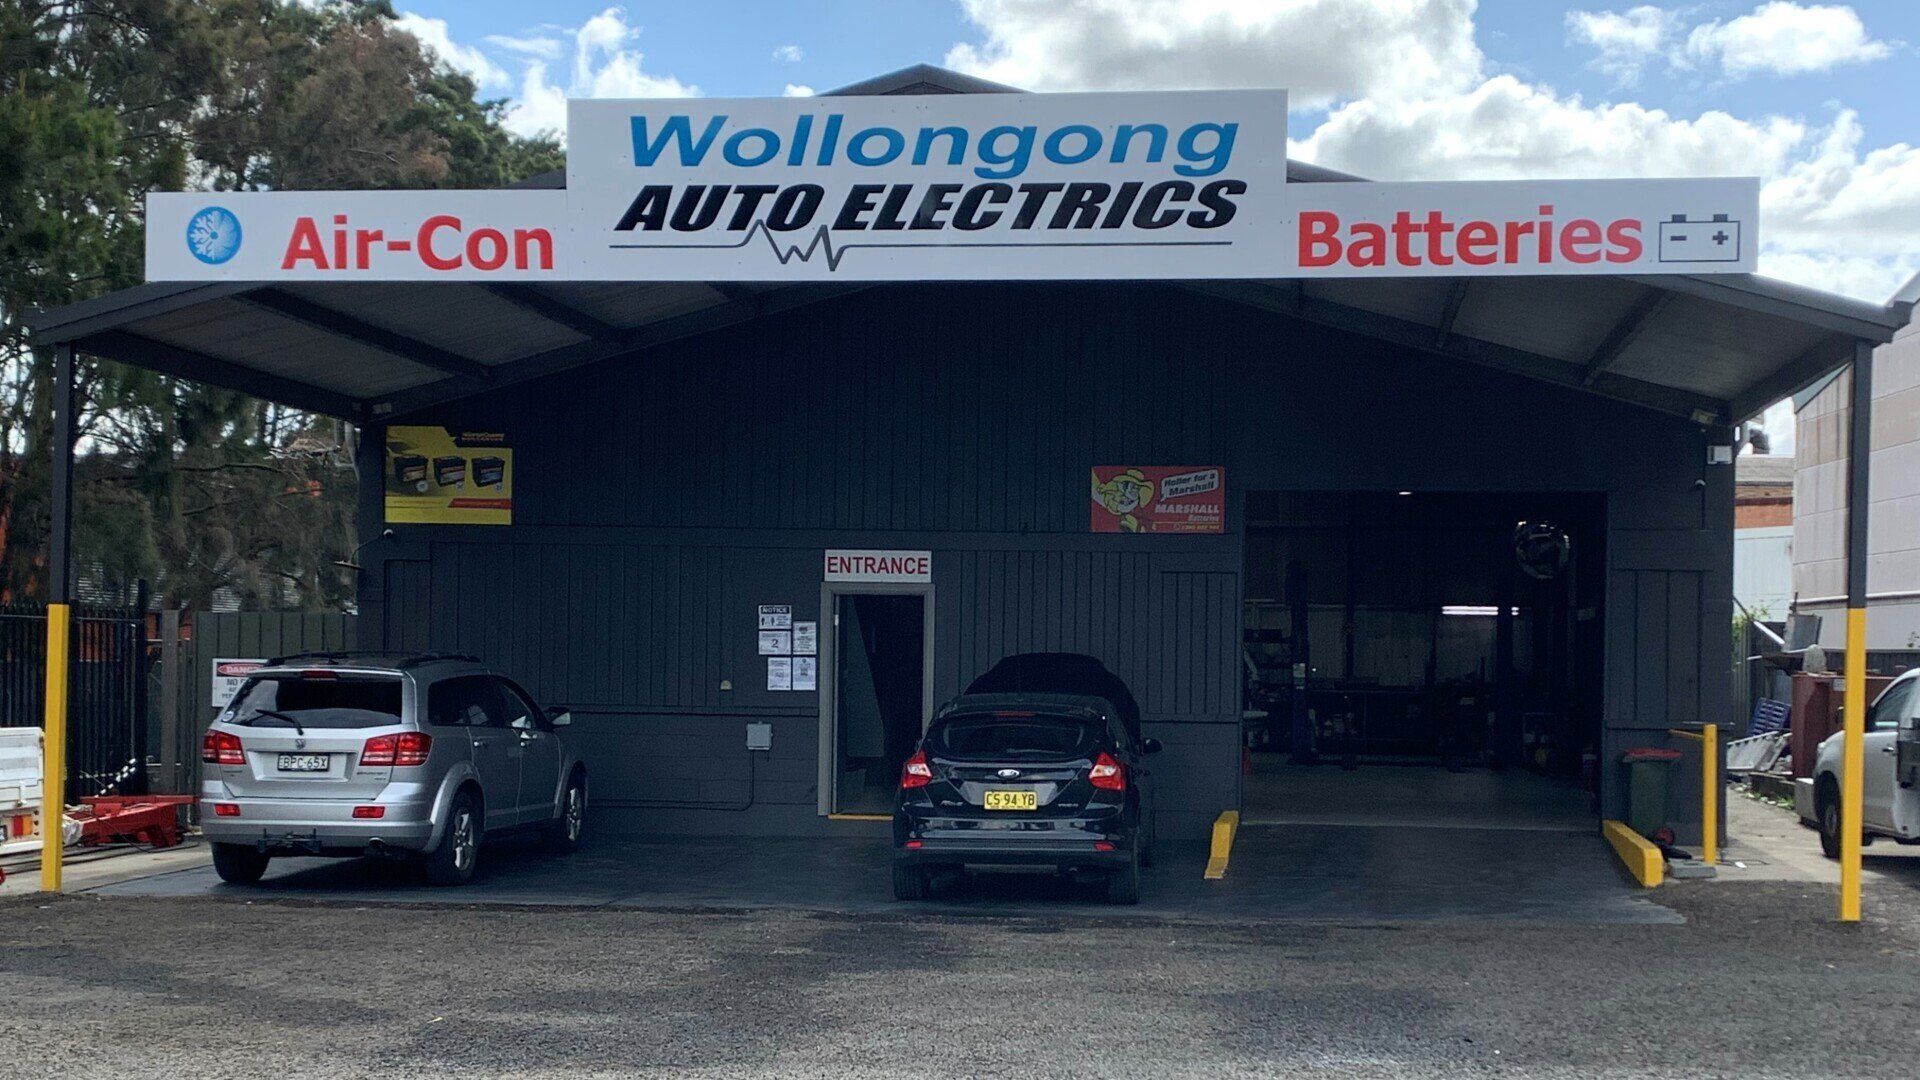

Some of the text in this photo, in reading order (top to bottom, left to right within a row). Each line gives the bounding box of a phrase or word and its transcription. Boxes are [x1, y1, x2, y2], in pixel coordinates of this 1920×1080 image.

[629, 114, 1239, 180] Wollongong
[614, 179, 1248, 231] AUTO ELECTRICS
[280, 214, 554, 272] Air-Con
[1298, 204, 1644, 268] Batteries
[1194, 474, 1208, 482] for
[1169, 481, 1214, 496] Marshall
[1155, 504, 1219, 513] MARSHALL
[827, 556, 928, 574] ENTRANCE
[771, 639, 779, 648] 2
